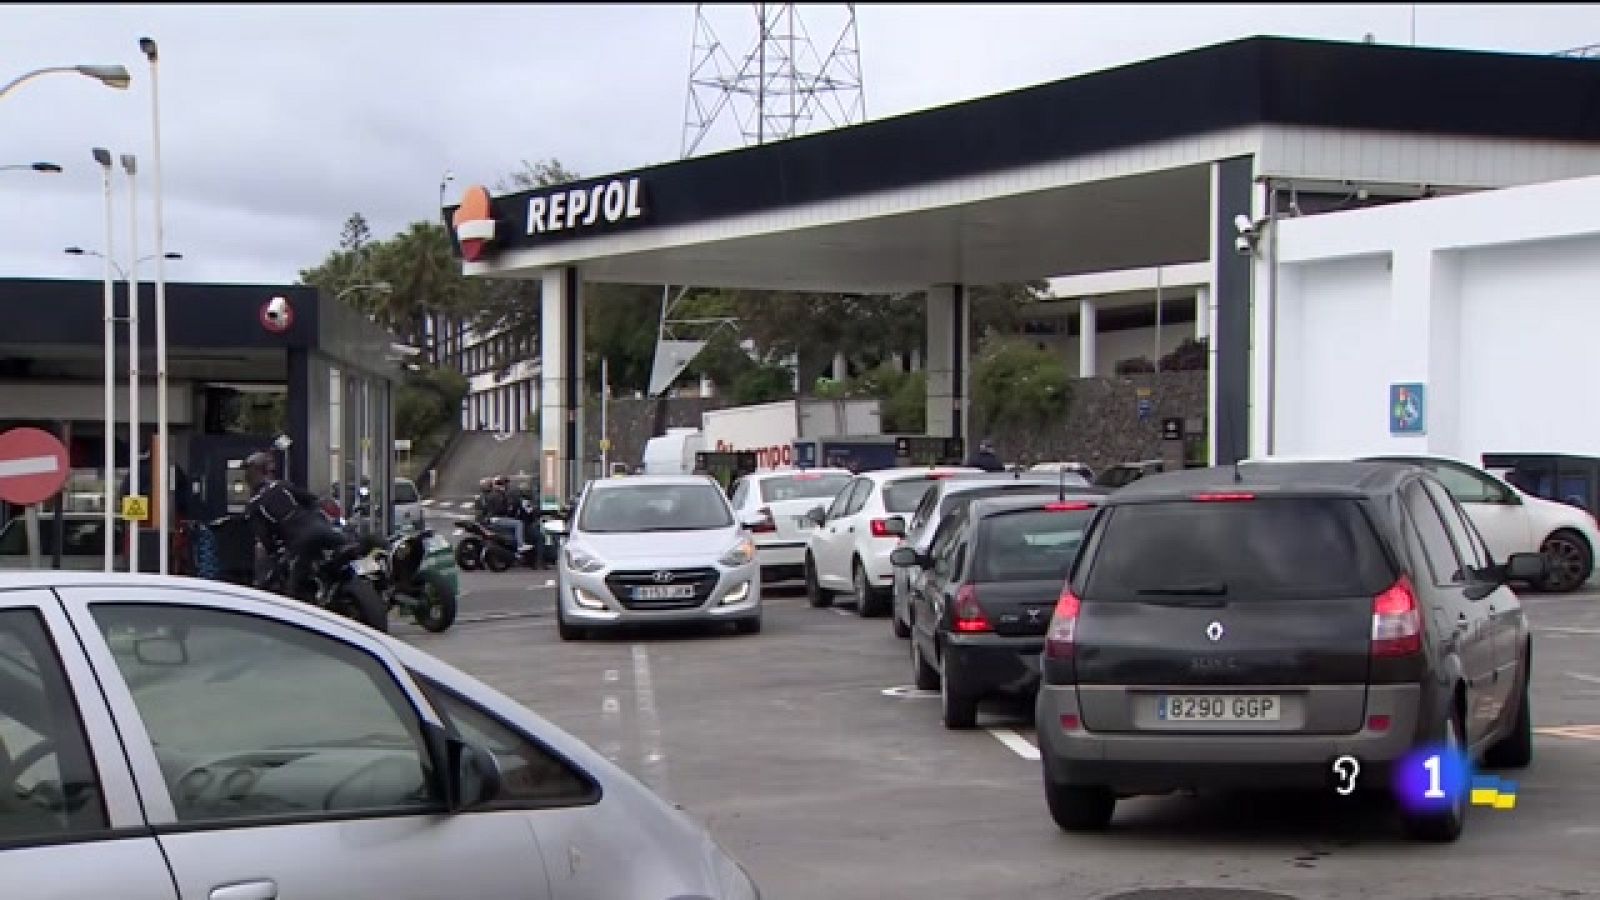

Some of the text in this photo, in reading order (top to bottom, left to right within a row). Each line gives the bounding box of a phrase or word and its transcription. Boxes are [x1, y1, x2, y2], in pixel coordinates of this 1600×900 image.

[526, 177, 641, 236] REPSOL
[1170, 697, 1273, 718] 8290 GGP
